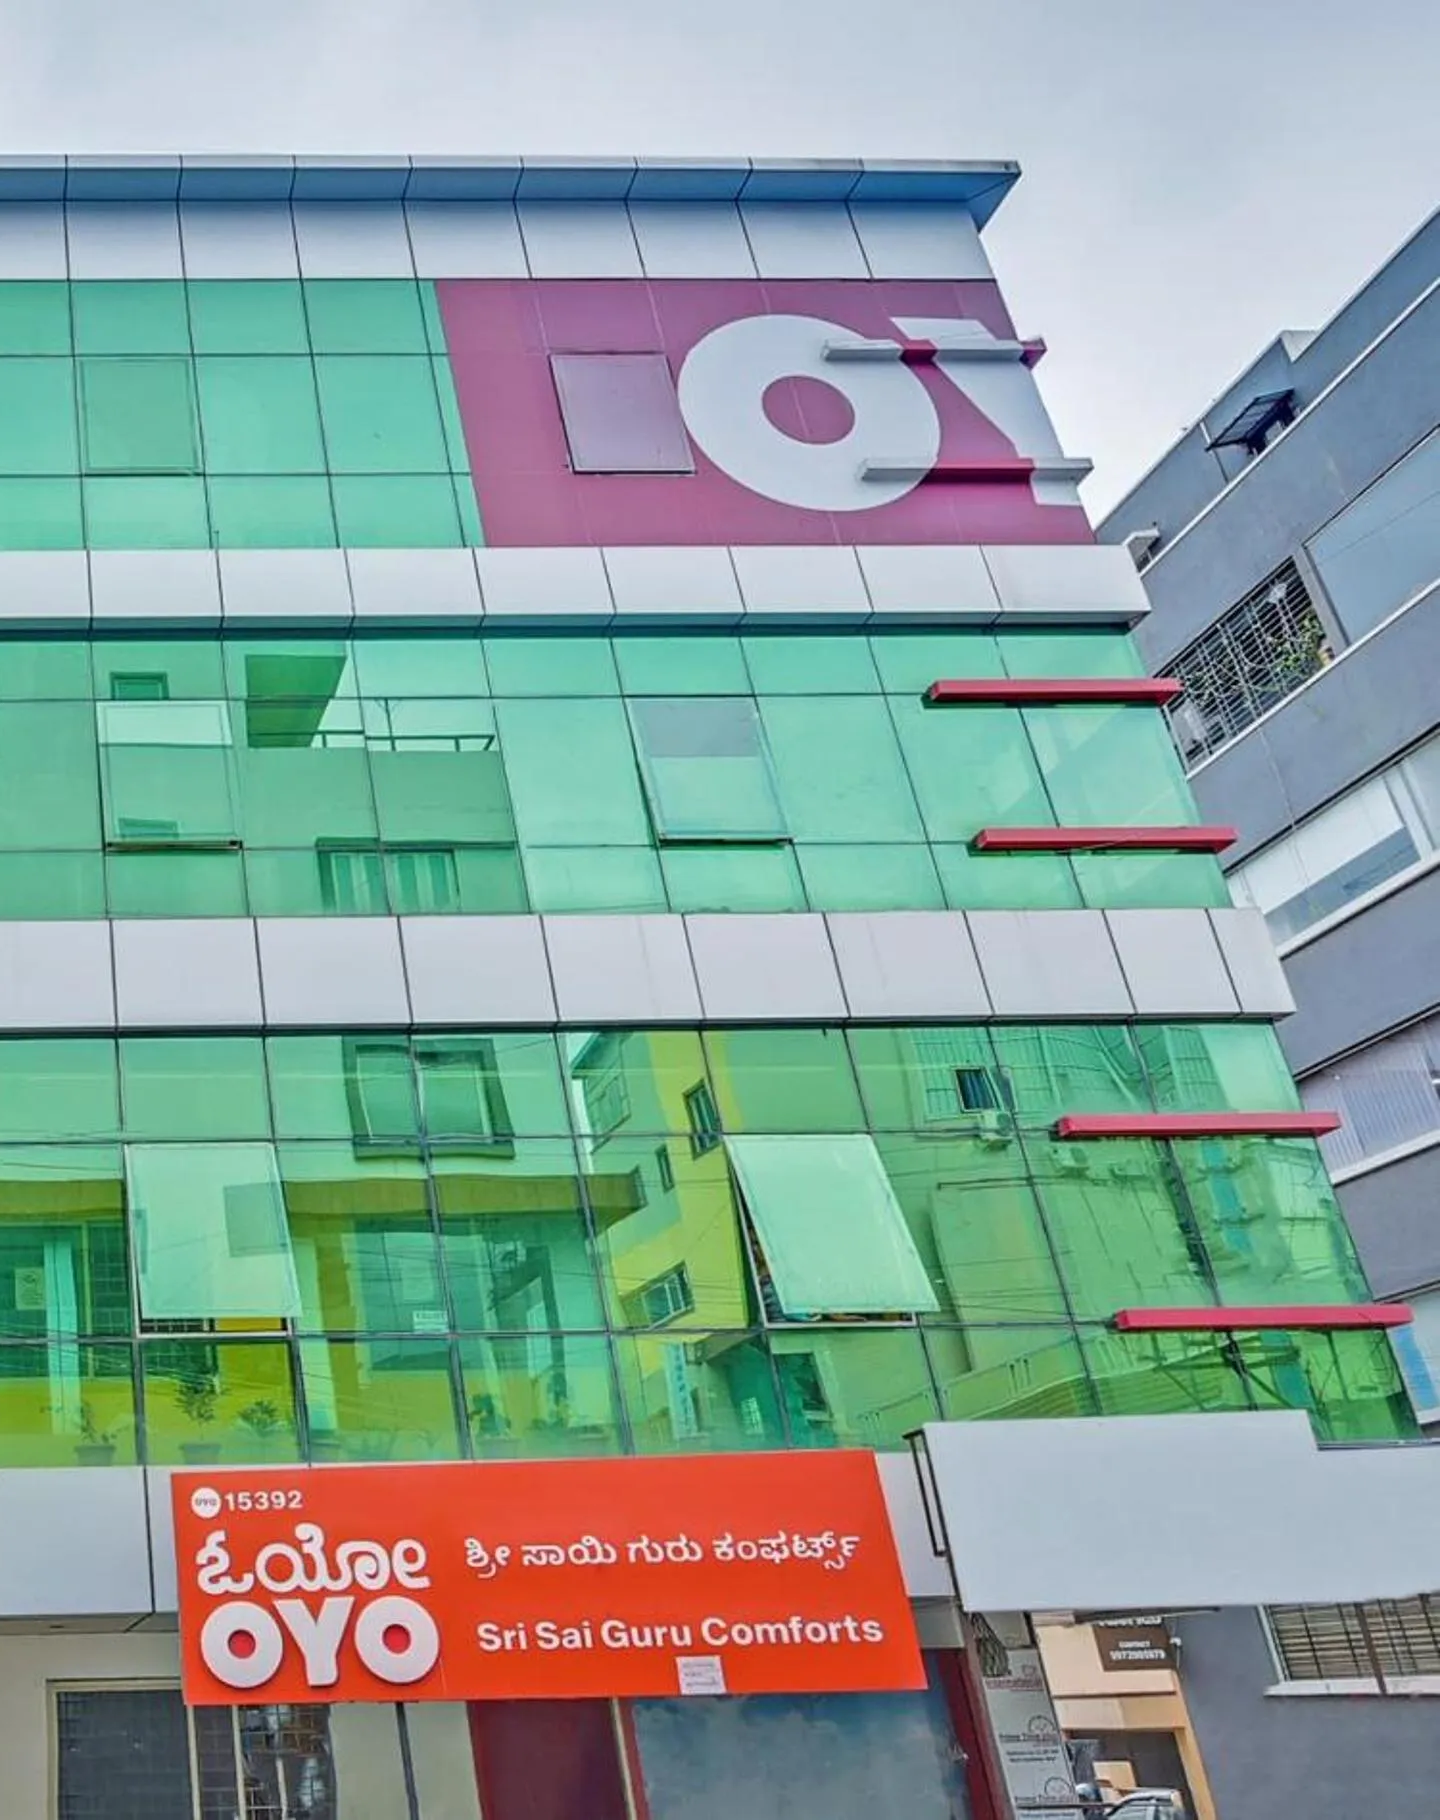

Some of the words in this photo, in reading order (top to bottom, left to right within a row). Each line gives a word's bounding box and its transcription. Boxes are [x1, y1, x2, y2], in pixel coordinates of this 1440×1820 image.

[224, 1490, 303, 1512] 15392
[196, 1522, 431, 1595] ಓಯೋ
[464, 1536, 511, 1579] ಶ್ರೀ
[521, 1535, 617, 1566] ಸಾಯಿ
[626, 1533, 703, 1564] ಗುರು
[200, 1595, 440, 1689] OYO
[477, 1622, 528, 1651] Sri
[535, 1620, 593, 1650] Sai
[600, 1618, 692, 1649] Guru
[700, 1615, 884, 1647] Comforts
